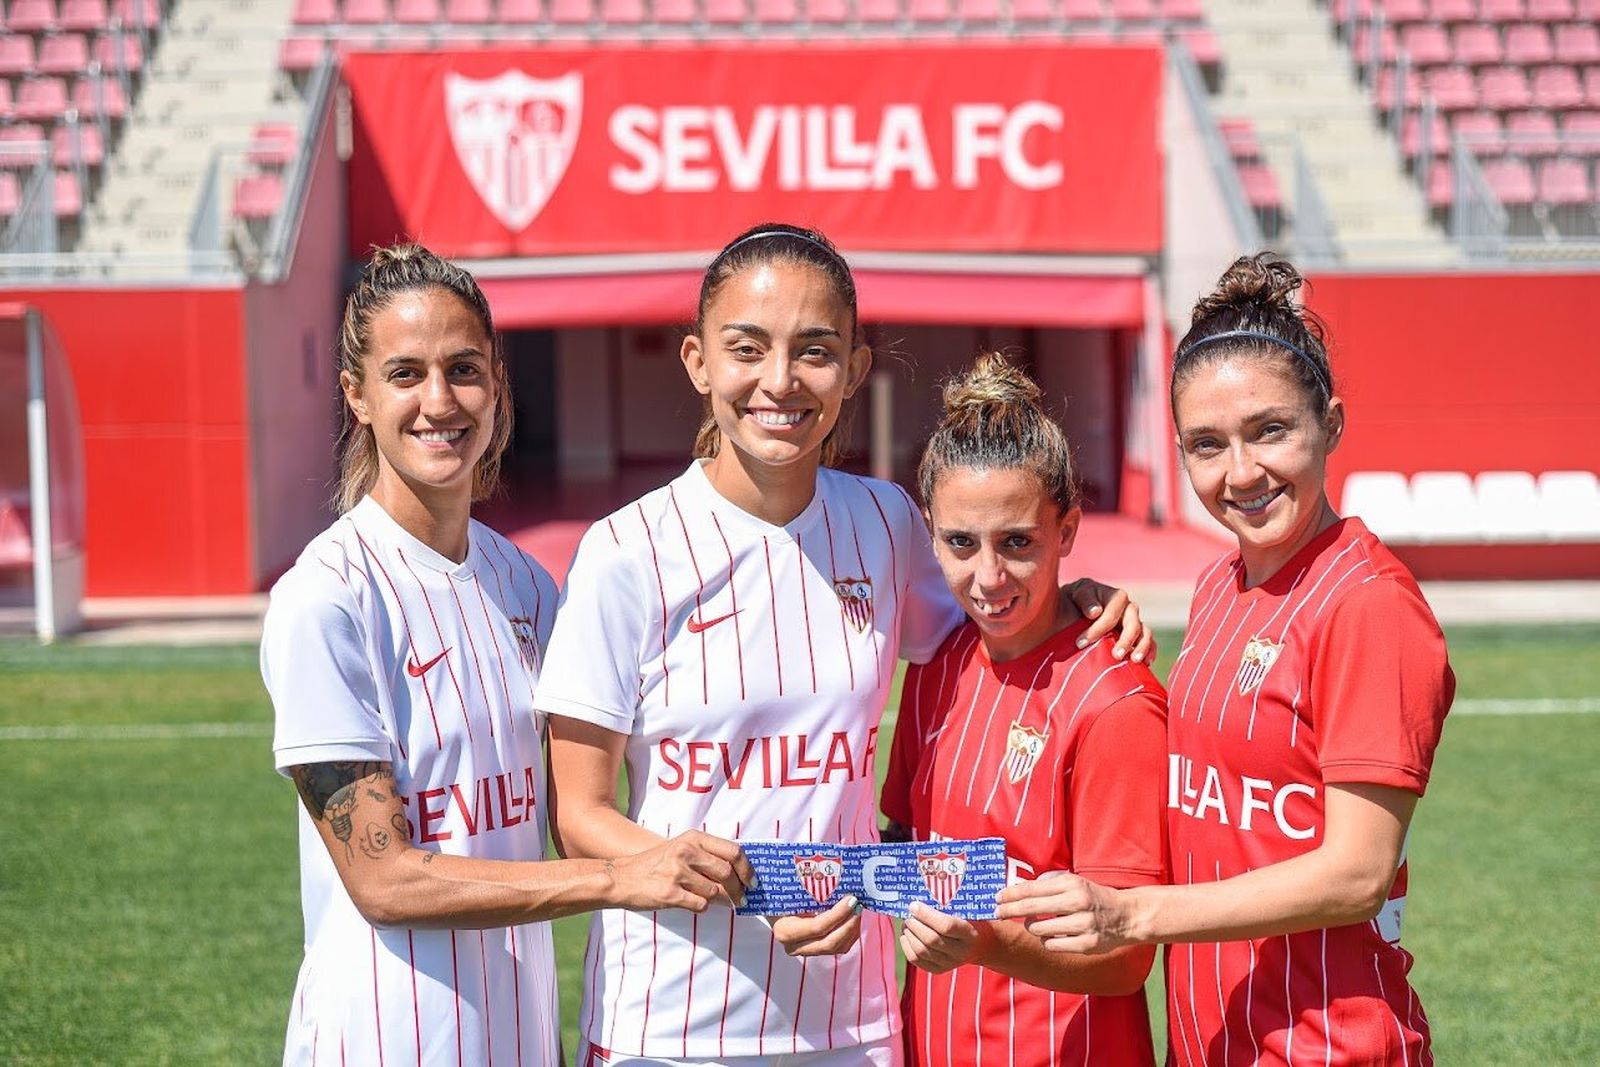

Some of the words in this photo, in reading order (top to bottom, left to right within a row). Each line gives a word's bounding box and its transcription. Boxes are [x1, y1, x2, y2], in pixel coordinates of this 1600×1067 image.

[608, 104, 937, 193] SEVILLA
[952, 101, 1064, 190] FC
[657, 731, 854, 794] SEVILLA
[862, 725, 878, 778] F
[1168, 754, 1229, 825] ILLA
[1239, 775, 1316, 840] FC
[863, 856, 898, 901] C
